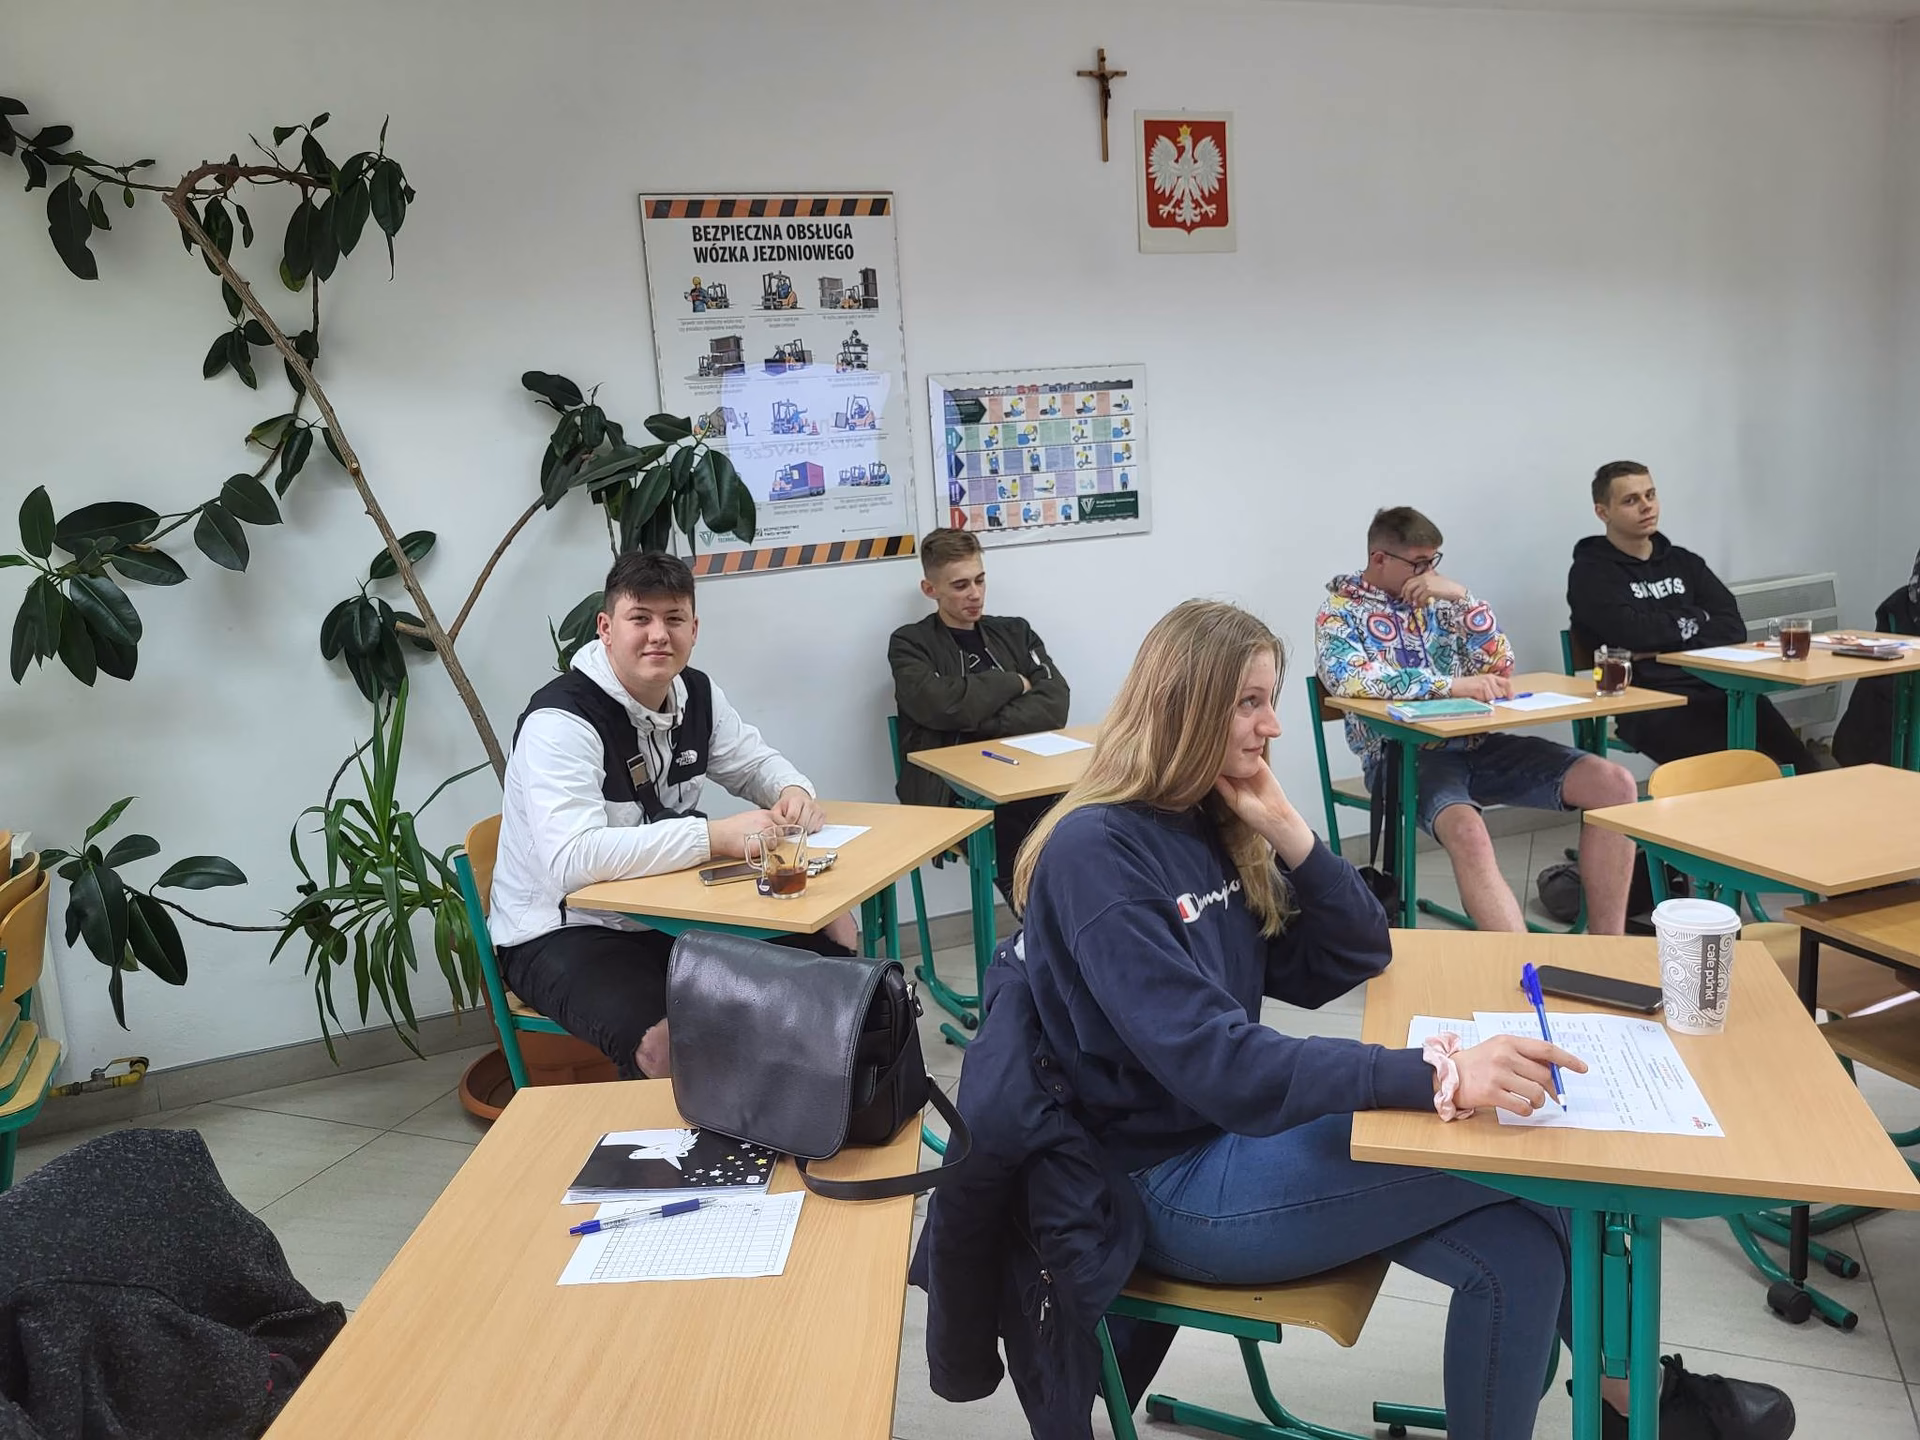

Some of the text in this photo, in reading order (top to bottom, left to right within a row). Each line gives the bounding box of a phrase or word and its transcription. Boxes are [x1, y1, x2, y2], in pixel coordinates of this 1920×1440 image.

[692, 223, 853, 242] BEZPIECZNA OBSŁUGA
[693, 243, 855, 263] WÓZKA JEZDNIOWEGO
